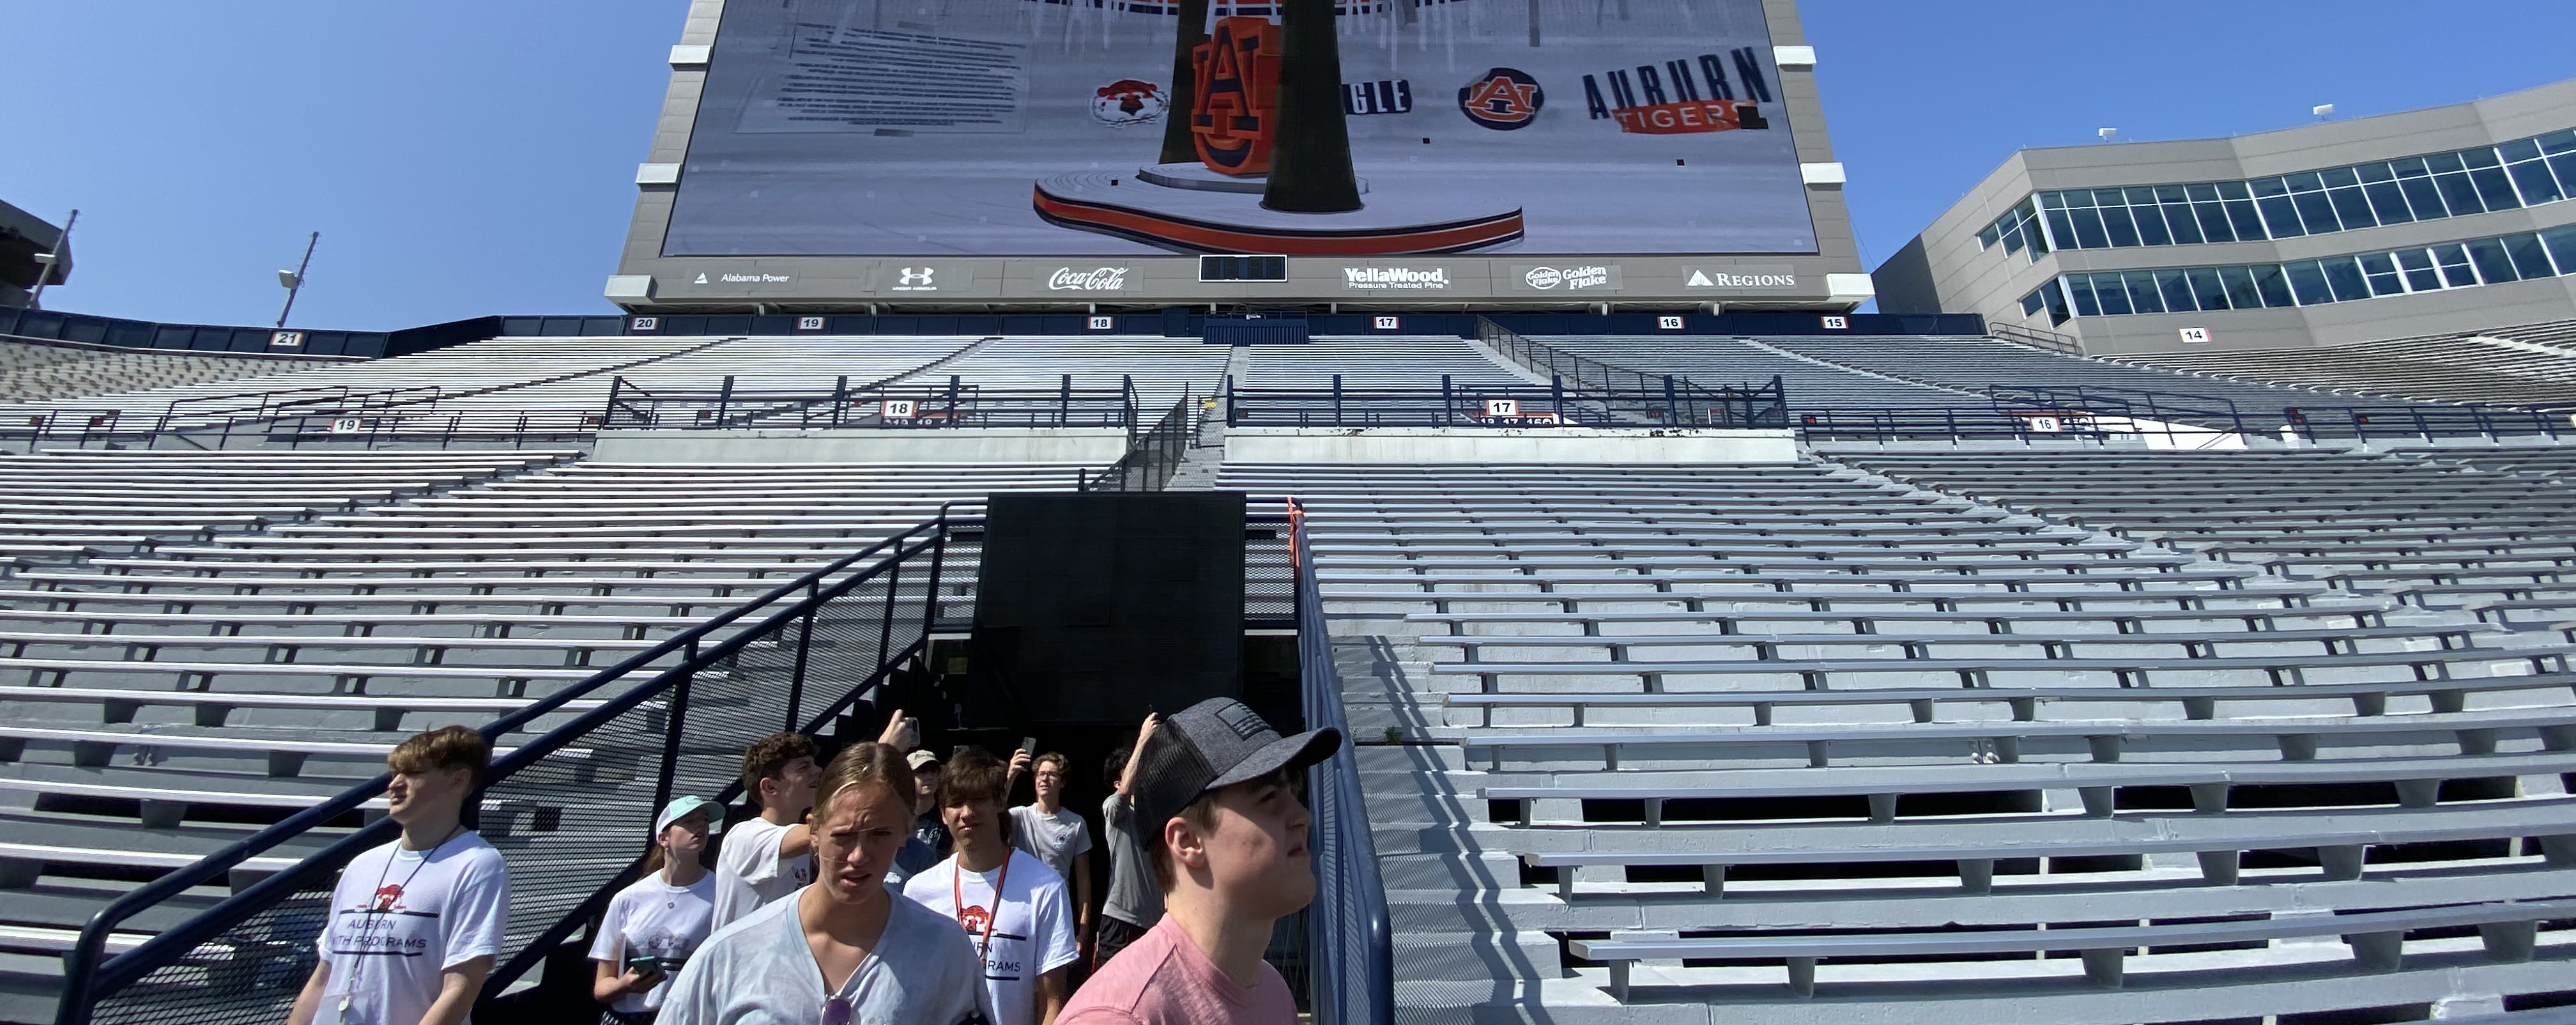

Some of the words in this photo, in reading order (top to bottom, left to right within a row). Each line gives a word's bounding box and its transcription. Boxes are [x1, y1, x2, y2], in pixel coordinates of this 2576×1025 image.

[1583, 47, 1772, 119] AUBURN
[1349, 81, 1407, 114] GLE
[1527, 271, 1559, 280] Golden
[1563, 266, 1607, 279] Golden
[721, 274, 760, 282] Alabama
[762, 274, 790, 282] Power
[1048, 267, 1130, 290] Coca-Cola
[1533, 277, 1559, 286] Flake
[1569, 275, 1607, 289] Flake
[1716, 273, 1795, 286] REGIONS
[637, 319, 654, 328] 20
[804, 319, 819, 328] 19
[1093, 319, 1108, 328] 18
[1379, 318, 1394, 327] 17
[1663, 318, 1678, 328] 16
[1827, 318, 1843, 327] 15
[279, 334, 297, 344] 21
[2186, 330, 2202, 340] 14
[890, 403, 908, 414] 18
[1493, 403, 1511, 413] 17
[339, 419, 356, 430] 19
[2039, 419, 2051, 429] 16
